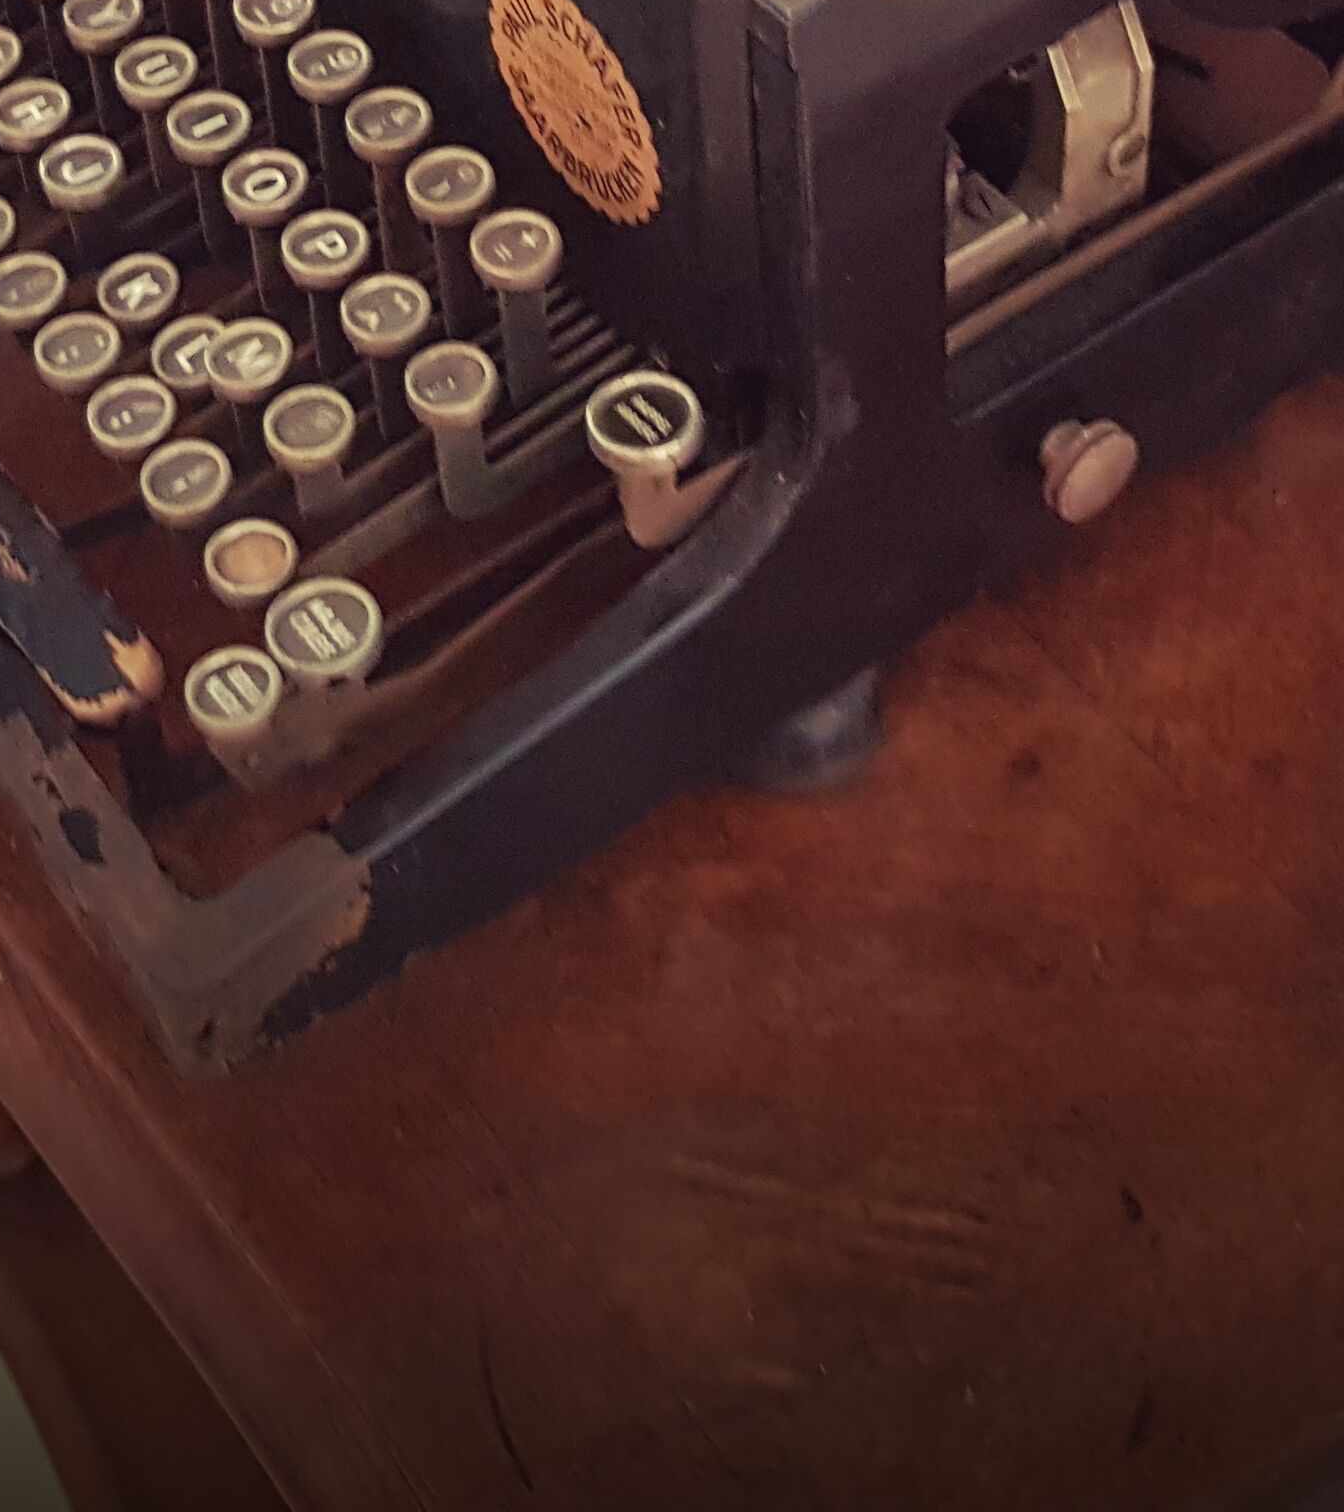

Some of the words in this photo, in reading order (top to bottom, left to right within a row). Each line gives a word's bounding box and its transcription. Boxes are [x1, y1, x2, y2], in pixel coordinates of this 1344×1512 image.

[11, 95, 54, 126] H
[61, 159, 104, 184] J
[117, 272, 162, 310] K
[174, 333, 209, 372] L
[137, 55, 178, 86] U
[192, 114, 228, 139] I
[245, 168, 287, 201] O
[301, 230, 347, 259] P
